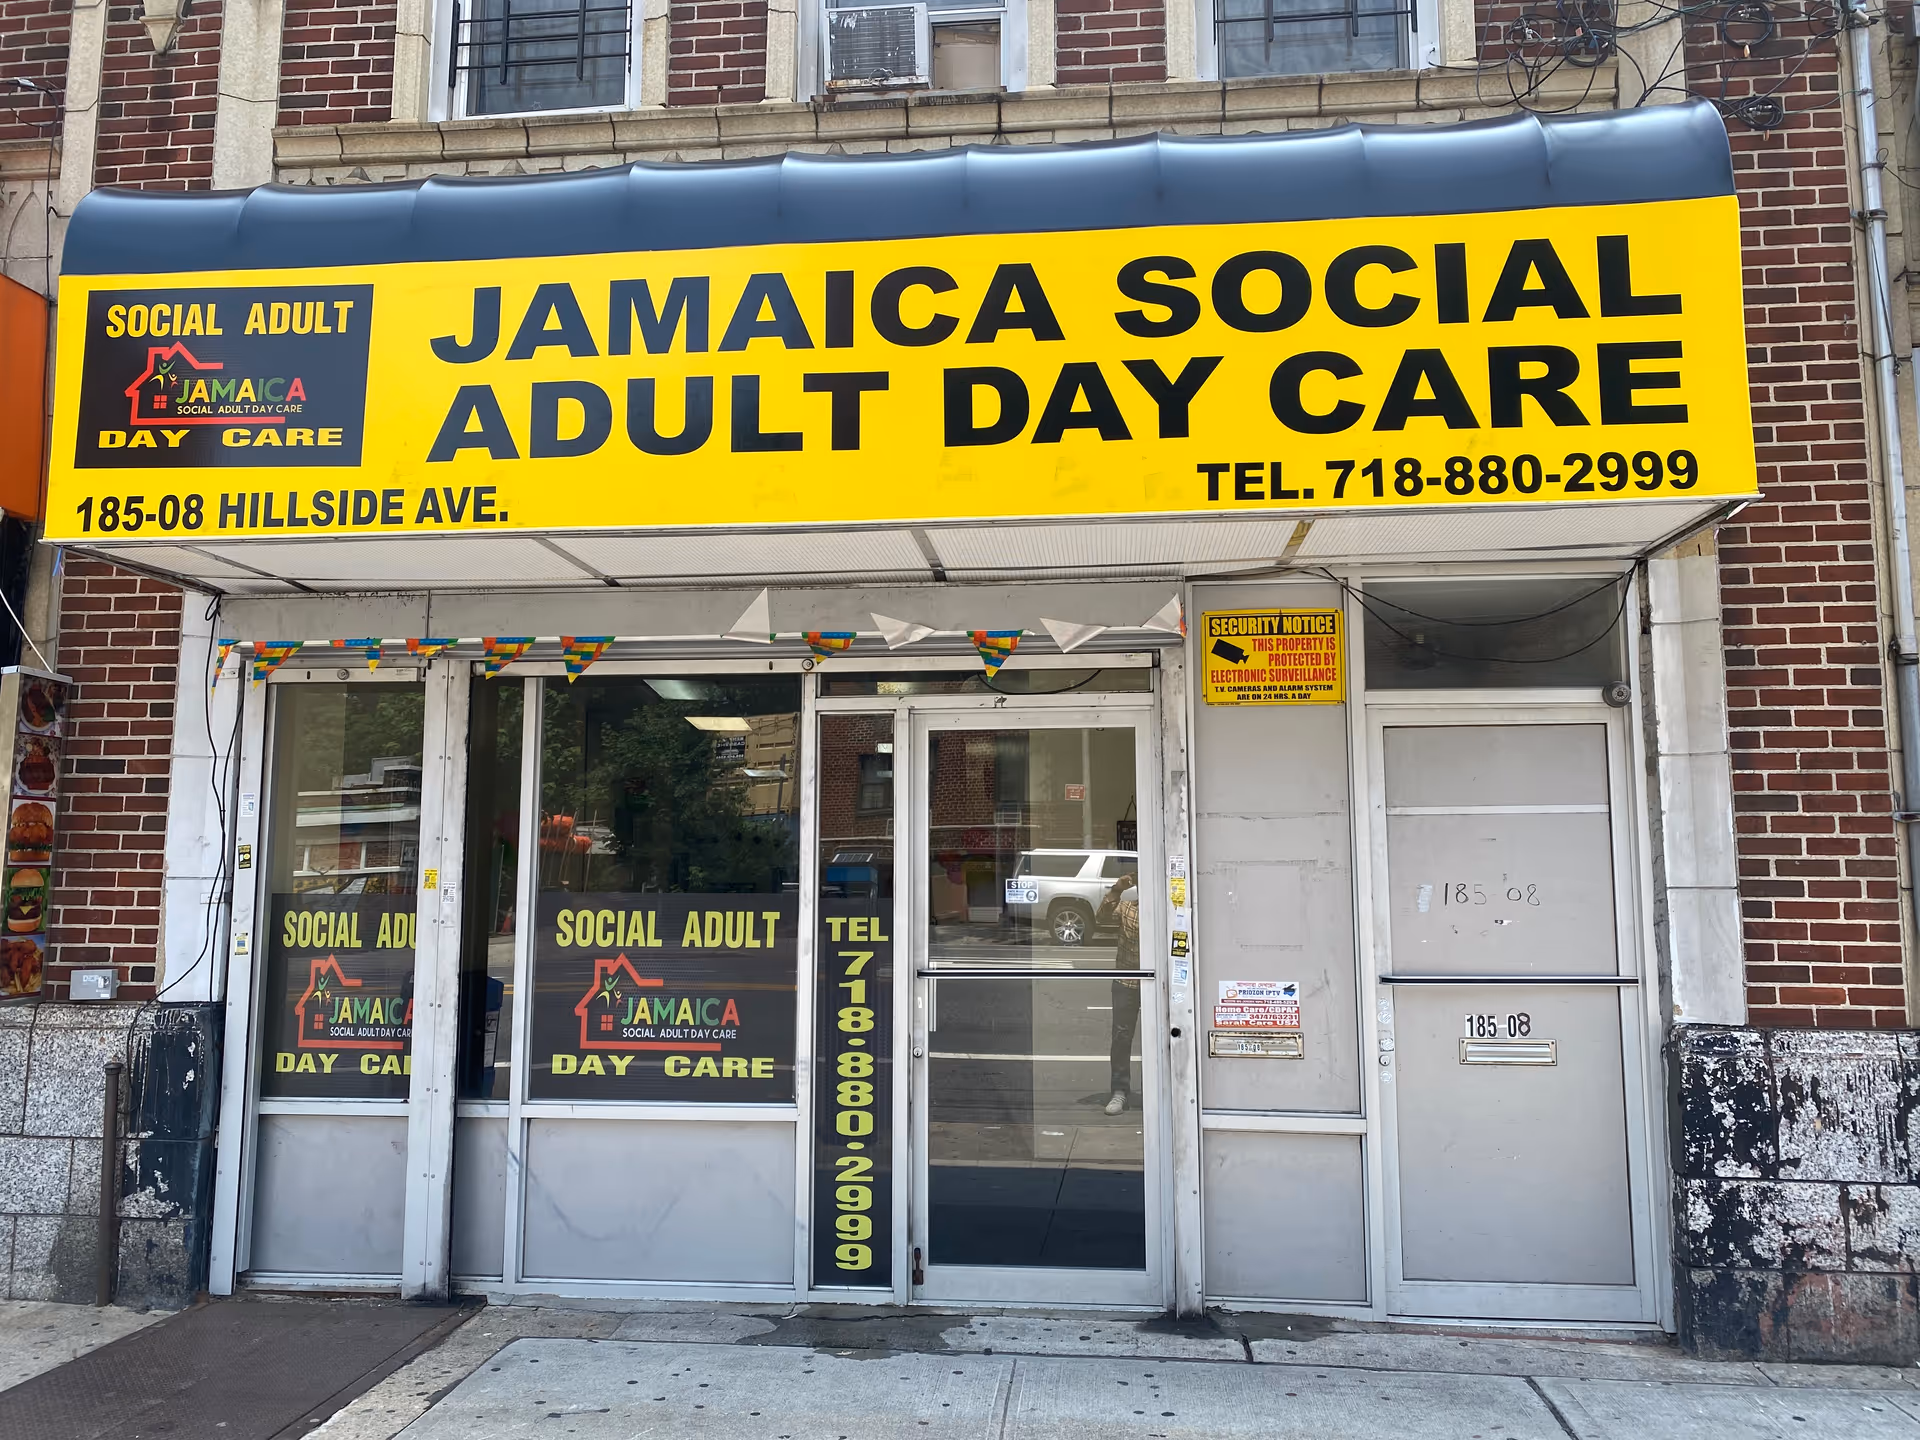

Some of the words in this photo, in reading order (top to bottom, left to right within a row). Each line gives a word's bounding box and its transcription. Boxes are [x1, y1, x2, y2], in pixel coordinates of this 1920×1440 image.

[430, 262, 1066, 364] JAMAICA
[1115, 234, 1683, 338] SOCIAL
[106, 302, 223, 339] SOCIAL
[244, 300, 354, 336] ADULT
[175, 377, 306, 404] JAMAICA
[425, 371, 889, 463] ADULT
[943, 356, 1224, 447] DAY
[1269, 340, 1689, 434] CARE
[177, 404, 213, 415] SOCIAL
[217, 404, 250, 415] ADULT
[251, 404, 275, 415] DAY
[276, 403, 303, 415] CARE
[98, 429, 191, 450] DAY
[221, 427, 344, 448] CARE
[1197, 462, 1314, 501] TEL.
[1326, 449, 1699, 498] 718-880-2999
[76, 493, 204, 533] 185-08
[218, 489, 405, 529] HILLSIDE
[414, 486, 508, 524] AVE.
[1211, 617, 1280, 635] SECURITY
[1283, 616, 1333, 634] NOTICE
[1252, 638, 1274, 651] THIS
[1276, 637, 1324, 651] PROPERTY
[1326, 637, 1336, 650] IS
[1268, 653, 1322, 666] PROTECTED
[1324, 652, 1336, 665] BY
[1211, 669, 1267, 683] ELECTRONIC
[1269, 668, 1337, 682] SURVEILLANCE
[1227, 685, 1262, 693] CAMERAS
[1297, 692, 1311, 700] DAY
[1011, 881, 1033, 889] STOP
[283, 910, 362, 948] SOCIAL
[376, 912, 416, 948] ADU
[555, 909, 662, 947] SOCIAL
[682, 911, 780, 948] ADULT
[825, 917, 889, 942] TEL
[620, 997, 740, 1026] JAMAICA
[330, 1027, 354, 1037] SOCIAL
[357, 1027, 381, 1037] ADULT
[381, 1028, 396, 1038] DAY
[397, 1028, 412, 1038] CAR
[622, 1027, 655, 1038] SOCIAL
[659, 1028, 690, 1039] ADULT
[691, 1029, 710, 1039] DAY
[712, 1029, 737, 1039] CARE
[275, 1053, 339, 1073] DAY
[360, 1054, 411, 1075] CA
[552, 1054, 635, 1075] DAY
[664, 1056, 774, 1078] CARE
